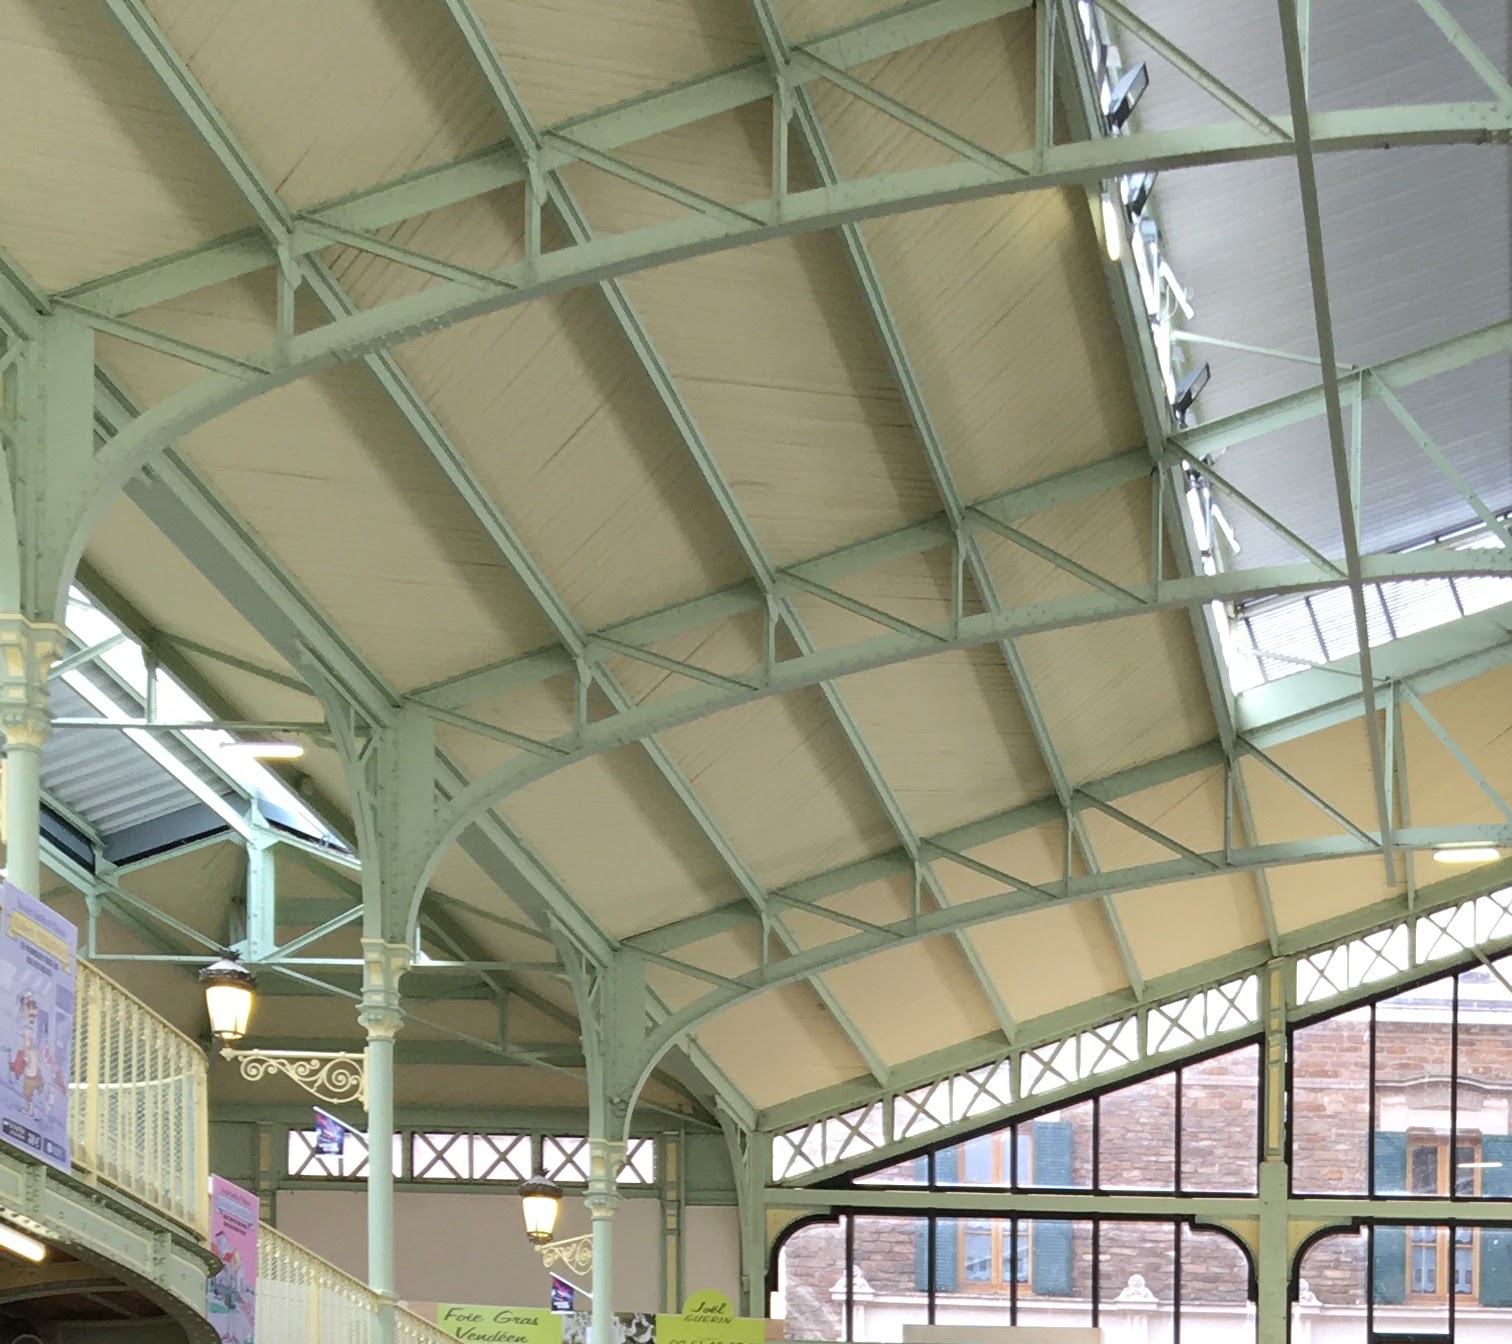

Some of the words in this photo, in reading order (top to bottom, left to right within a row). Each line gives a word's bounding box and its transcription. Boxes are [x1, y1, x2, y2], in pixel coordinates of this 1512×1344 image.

[442, 1306, 482, 1324] Foie
[492, 1309, 538, 1327] Gras
[688, 1301, 726, 1316] Joël
[683, 1314, 733, 1326] GUERIN
[453, 1326, 529, 1344] Vendéen
